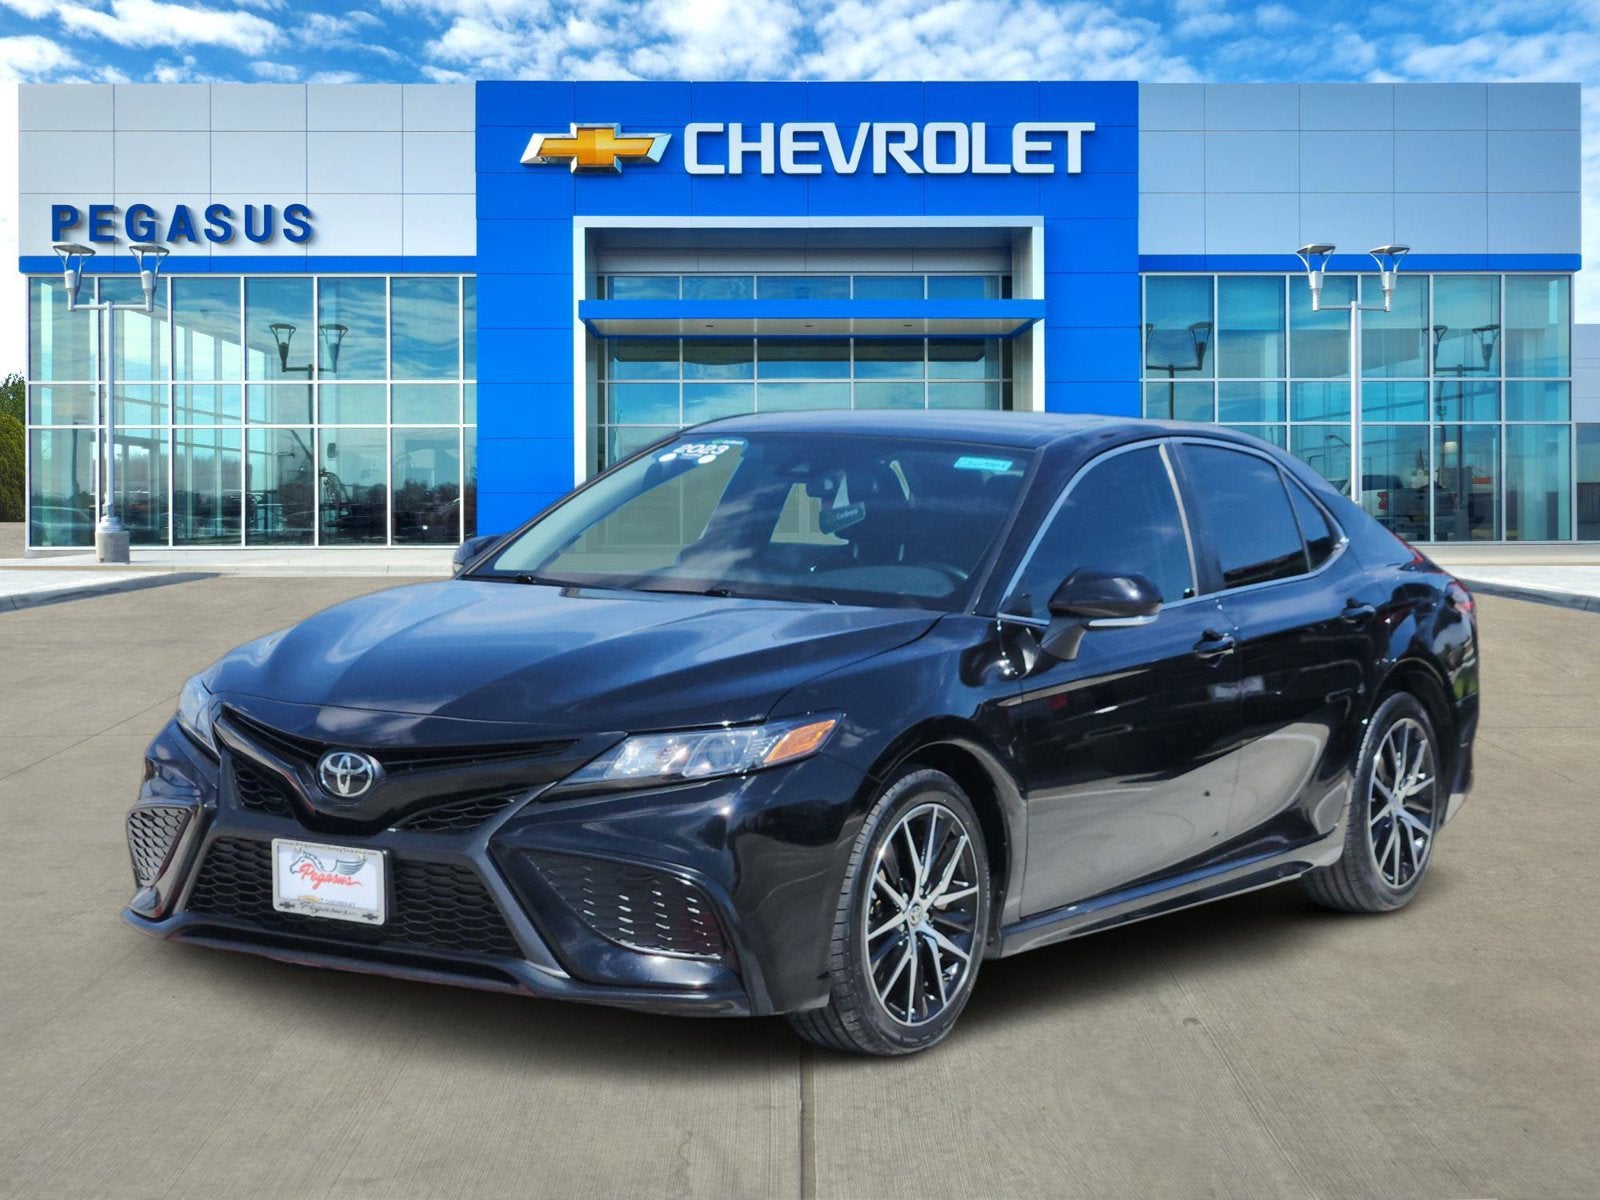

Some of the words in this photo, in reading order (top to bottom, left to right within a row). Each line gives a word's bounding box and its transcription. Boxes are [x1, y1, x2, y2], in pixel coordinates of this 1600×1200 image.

[684, 122, 1096, 175] CHEVROLET
[51, 203, 315, 243] PEGASUS
[299, 863, 363, 890] Pegasus
